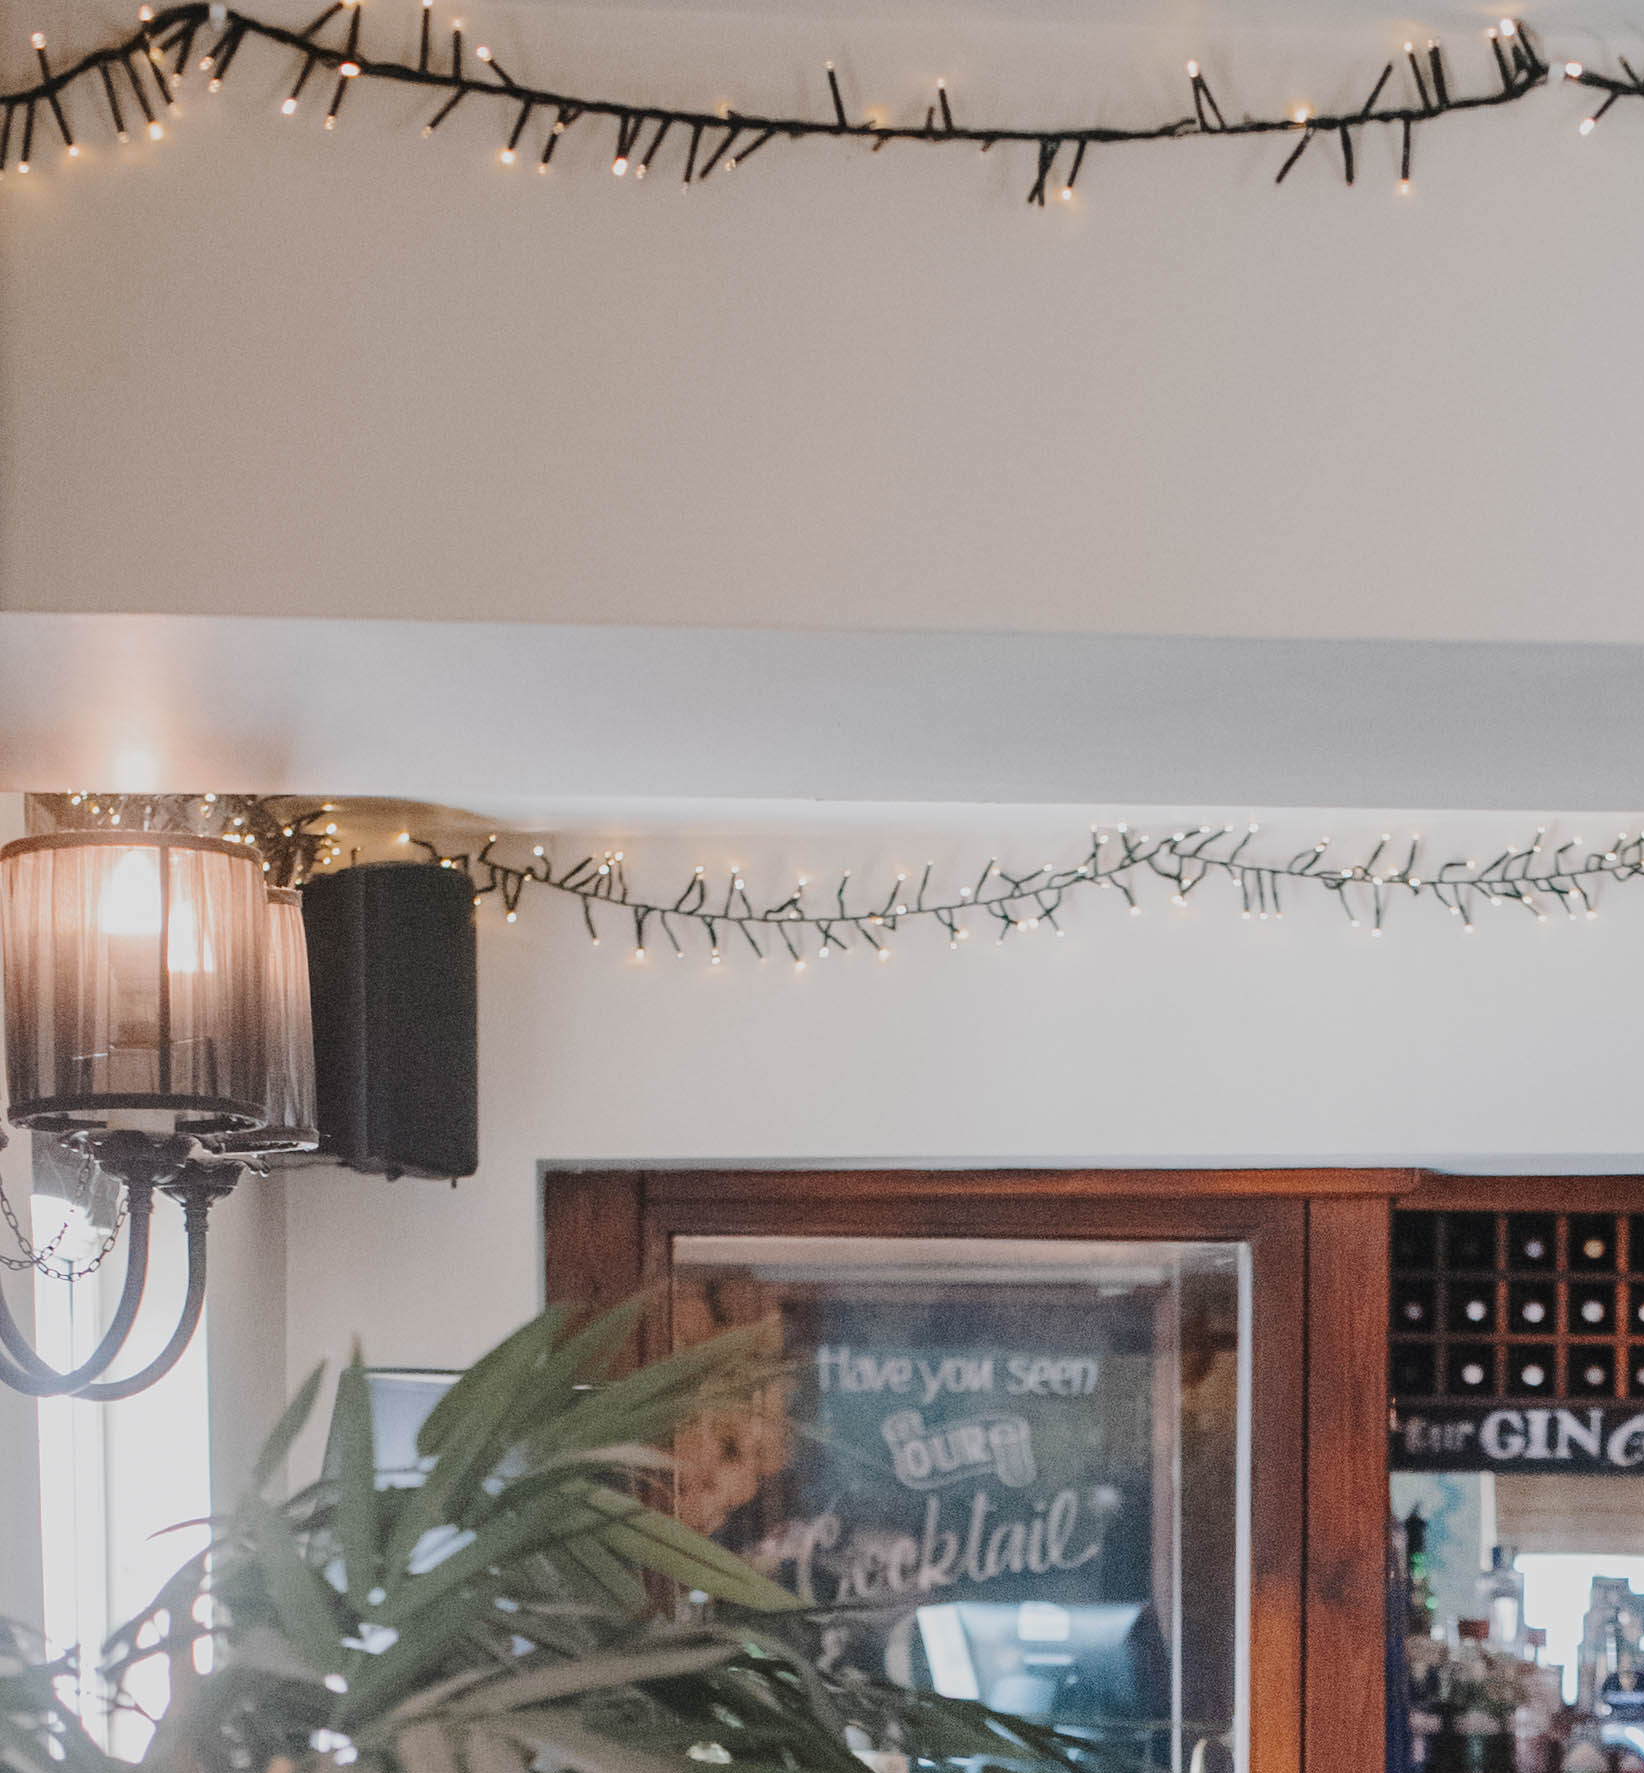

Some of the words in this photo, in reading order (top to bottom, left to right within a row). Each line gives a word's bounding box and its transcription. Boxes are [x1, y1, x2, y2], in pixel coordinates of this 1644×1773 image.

[815, 1343, 911, 1395] Have
[921, 1354, 994, 1402] you
[1008, 1354, 1100, 1397] seen
[899, 1424, 992, 1480] OUR
[1479, 1407, 1605, 1460] GIN
[796, 1489, 1100, 1606] Cocktail
